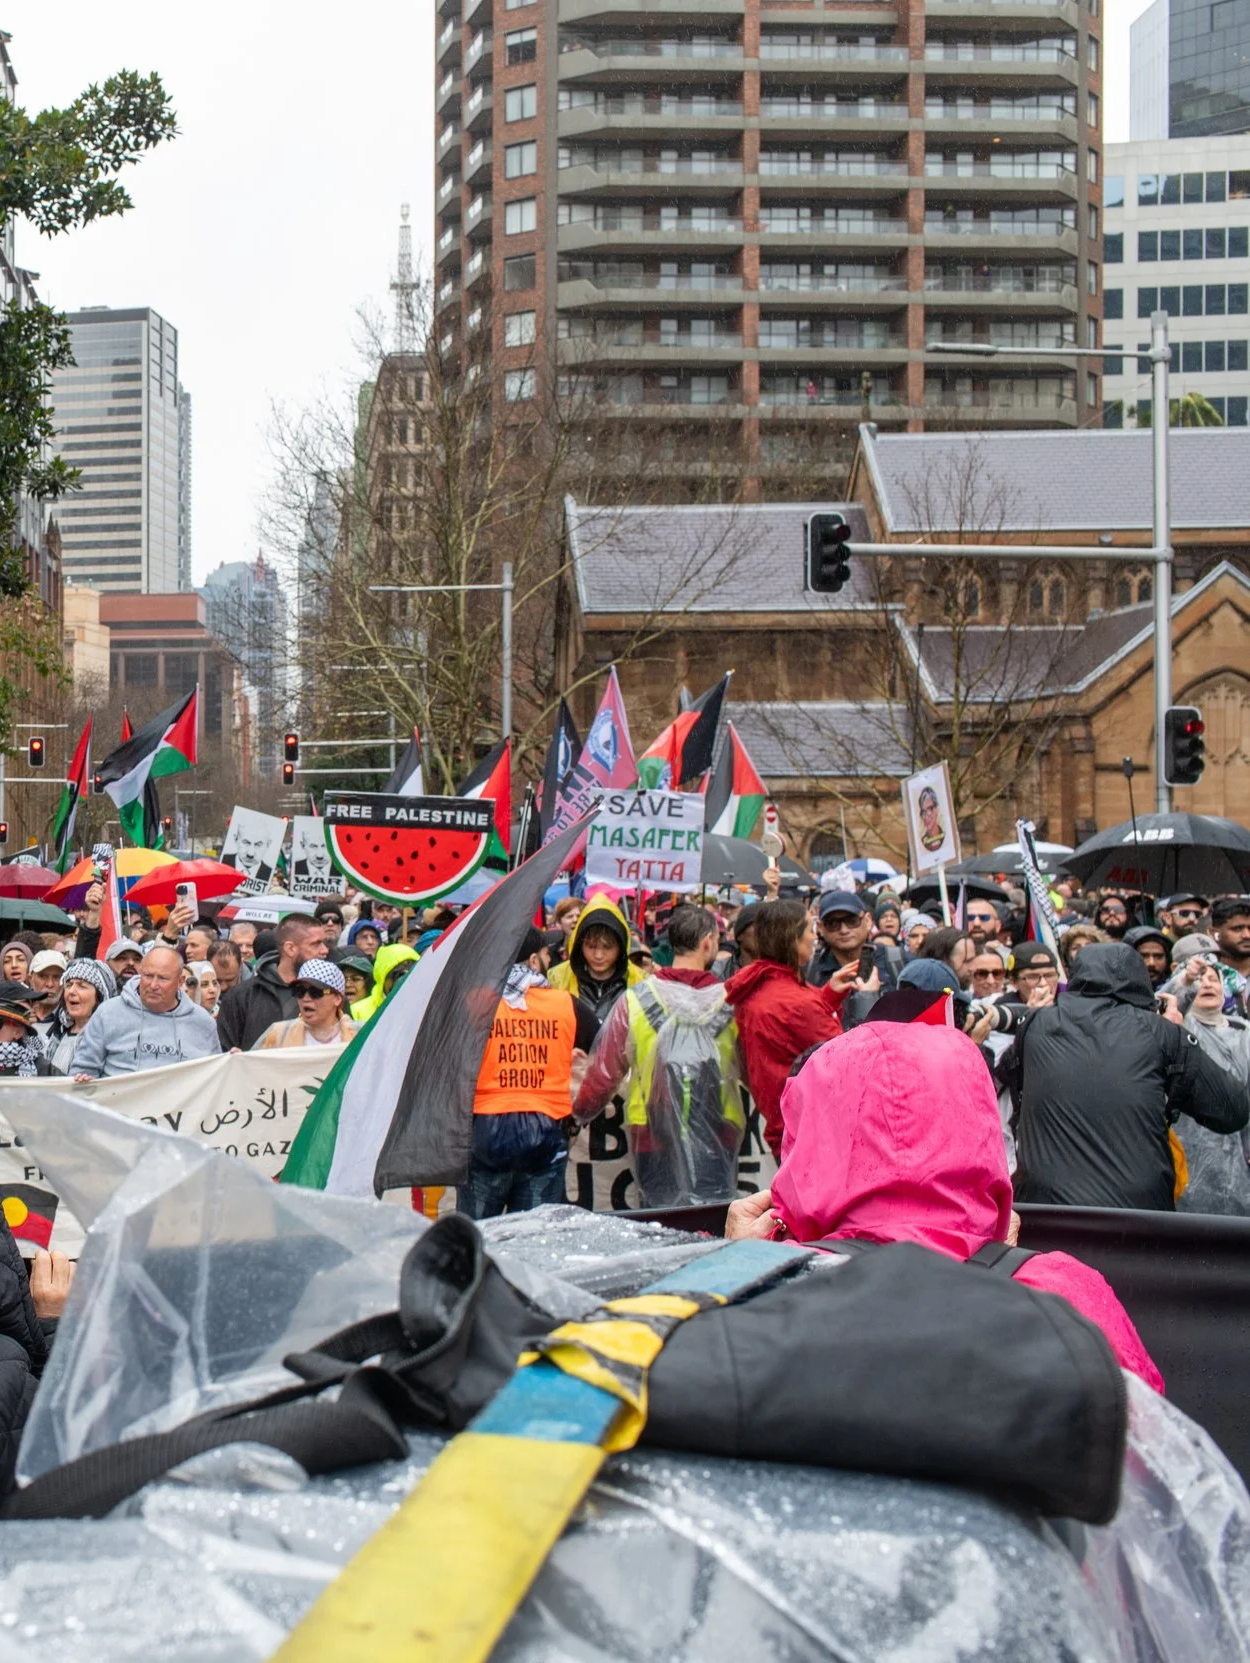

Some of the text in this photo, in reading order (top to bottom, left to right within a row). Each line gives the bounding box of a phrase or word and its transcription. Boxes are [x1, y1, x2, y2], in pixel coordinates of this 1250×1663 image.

[325, 804, 490, 826] FREE PALESTINE
[608, 795, 684, 818] SAVE
[588, 824, 701, 852] MASAFER
[1122, 828, 1175, 843] ABB
[294, 876, 342, 885] WAR
[615, 858, 686, 882] YATTA
[240, 878, 269, 894] ORIST
[293, 883, 342, 894] CRIMINAL
[245, 910, 261, 919] WILL
[498, 1042, 548, 1064] ACTION
[499, 1068, 545, 1089] GROUP
[200, 1087, 288, 1135] الأرض
[246, 1140, 292, 1158] GAZ
